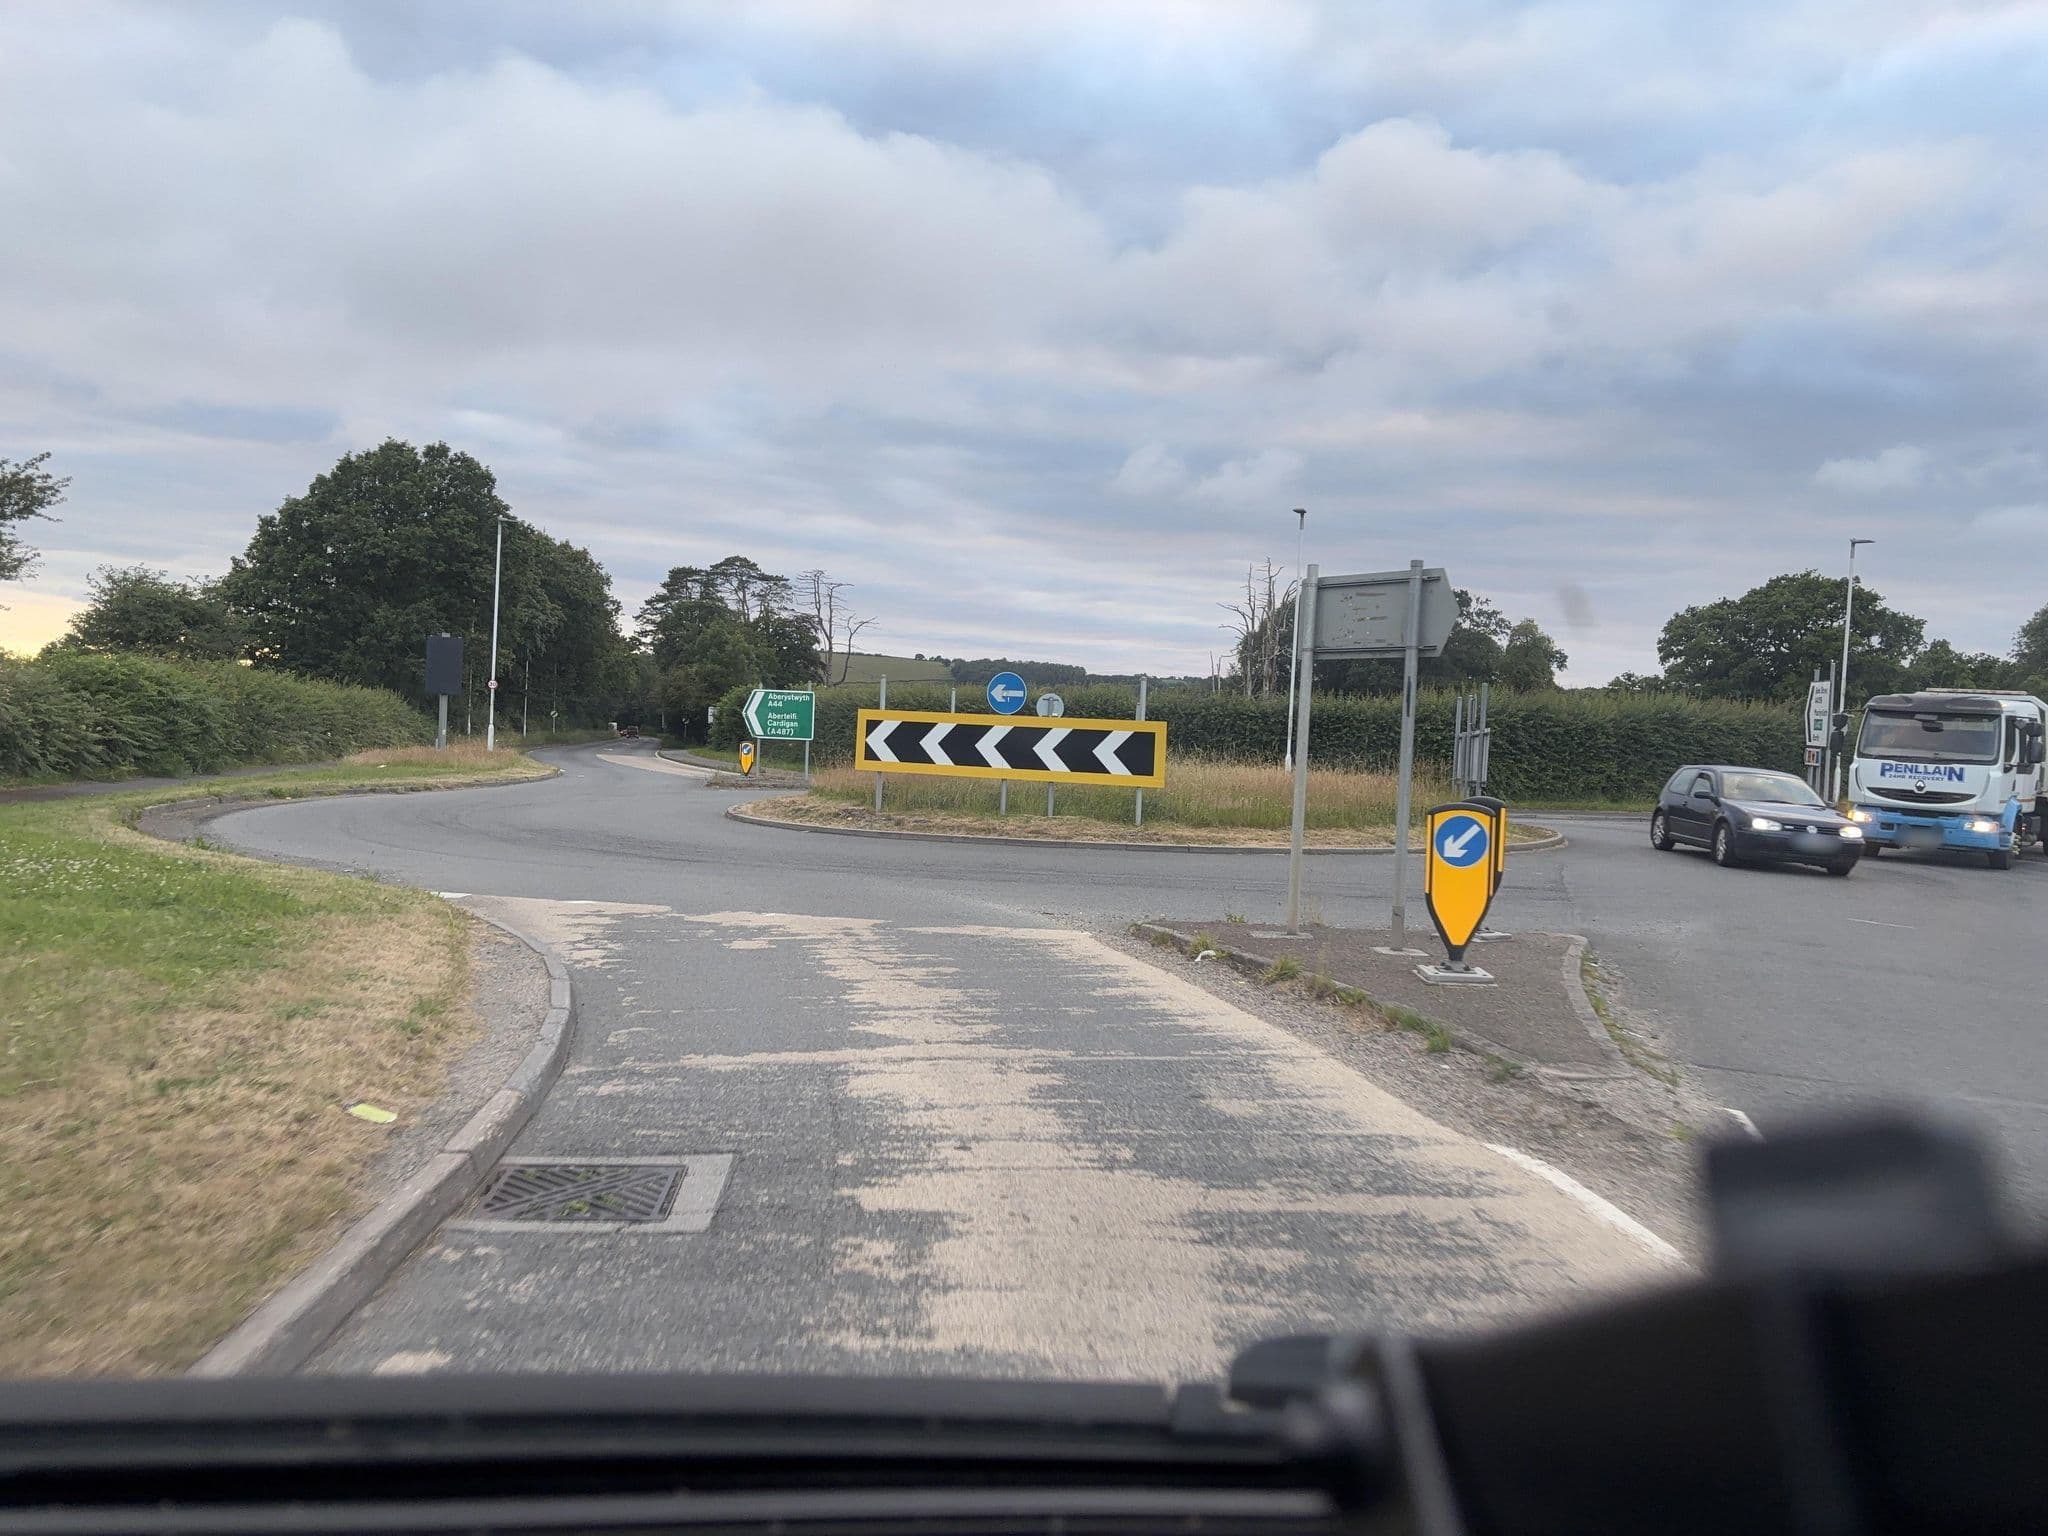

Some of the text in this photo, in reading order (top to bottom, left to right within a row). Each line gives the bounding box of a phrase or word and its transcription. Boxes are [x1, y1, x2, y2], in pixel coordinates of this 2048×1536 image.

[768, 693, 810, 702] Aberystwyth
[768, 712, 797, 720] Aberteifi
[767, 719, 799, 728] Cardigan
[767, 727, 794, 736] (A487)
[1880, 762, 1964, 781] PENLLAIN
